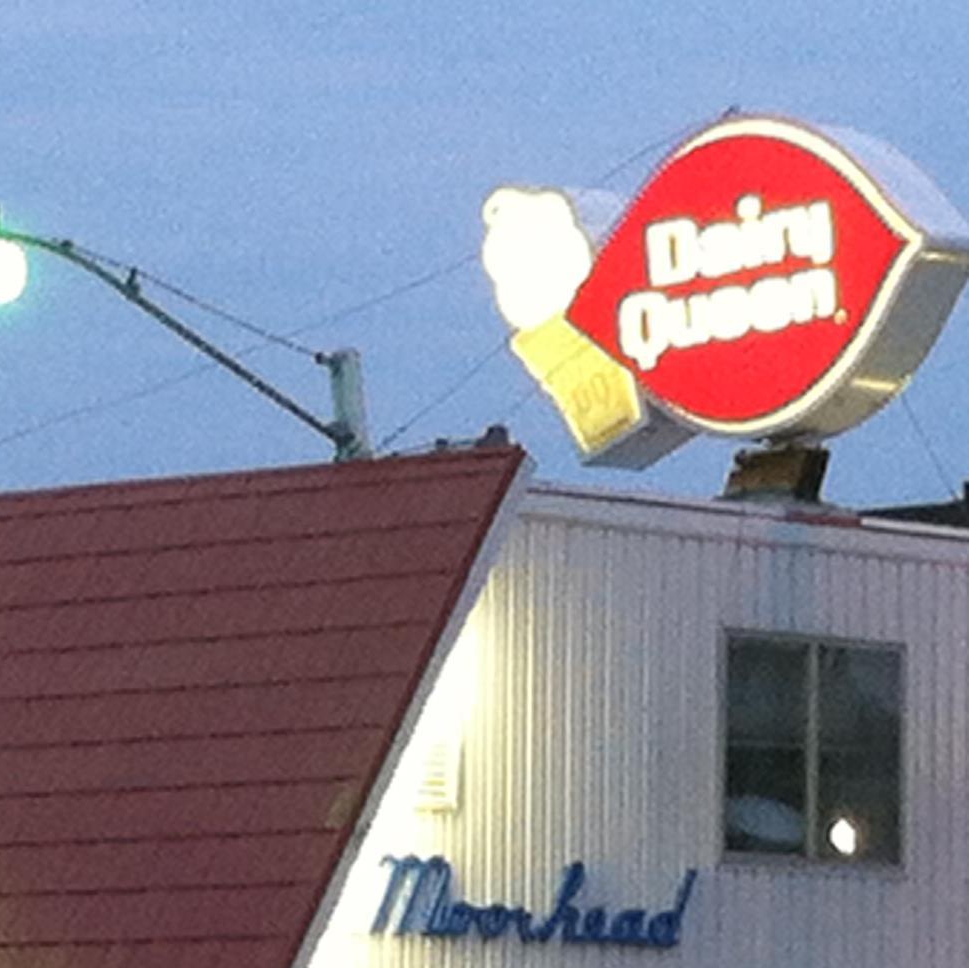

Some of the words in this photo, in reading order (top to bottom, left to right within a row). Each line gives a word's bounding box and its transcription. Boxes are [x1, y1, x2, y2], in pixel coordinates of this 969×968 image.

[645, 195, 833, 287] Dairy
[617, 268, 837, 370] Queen
[371, 854, 697, 947] Moorhead
